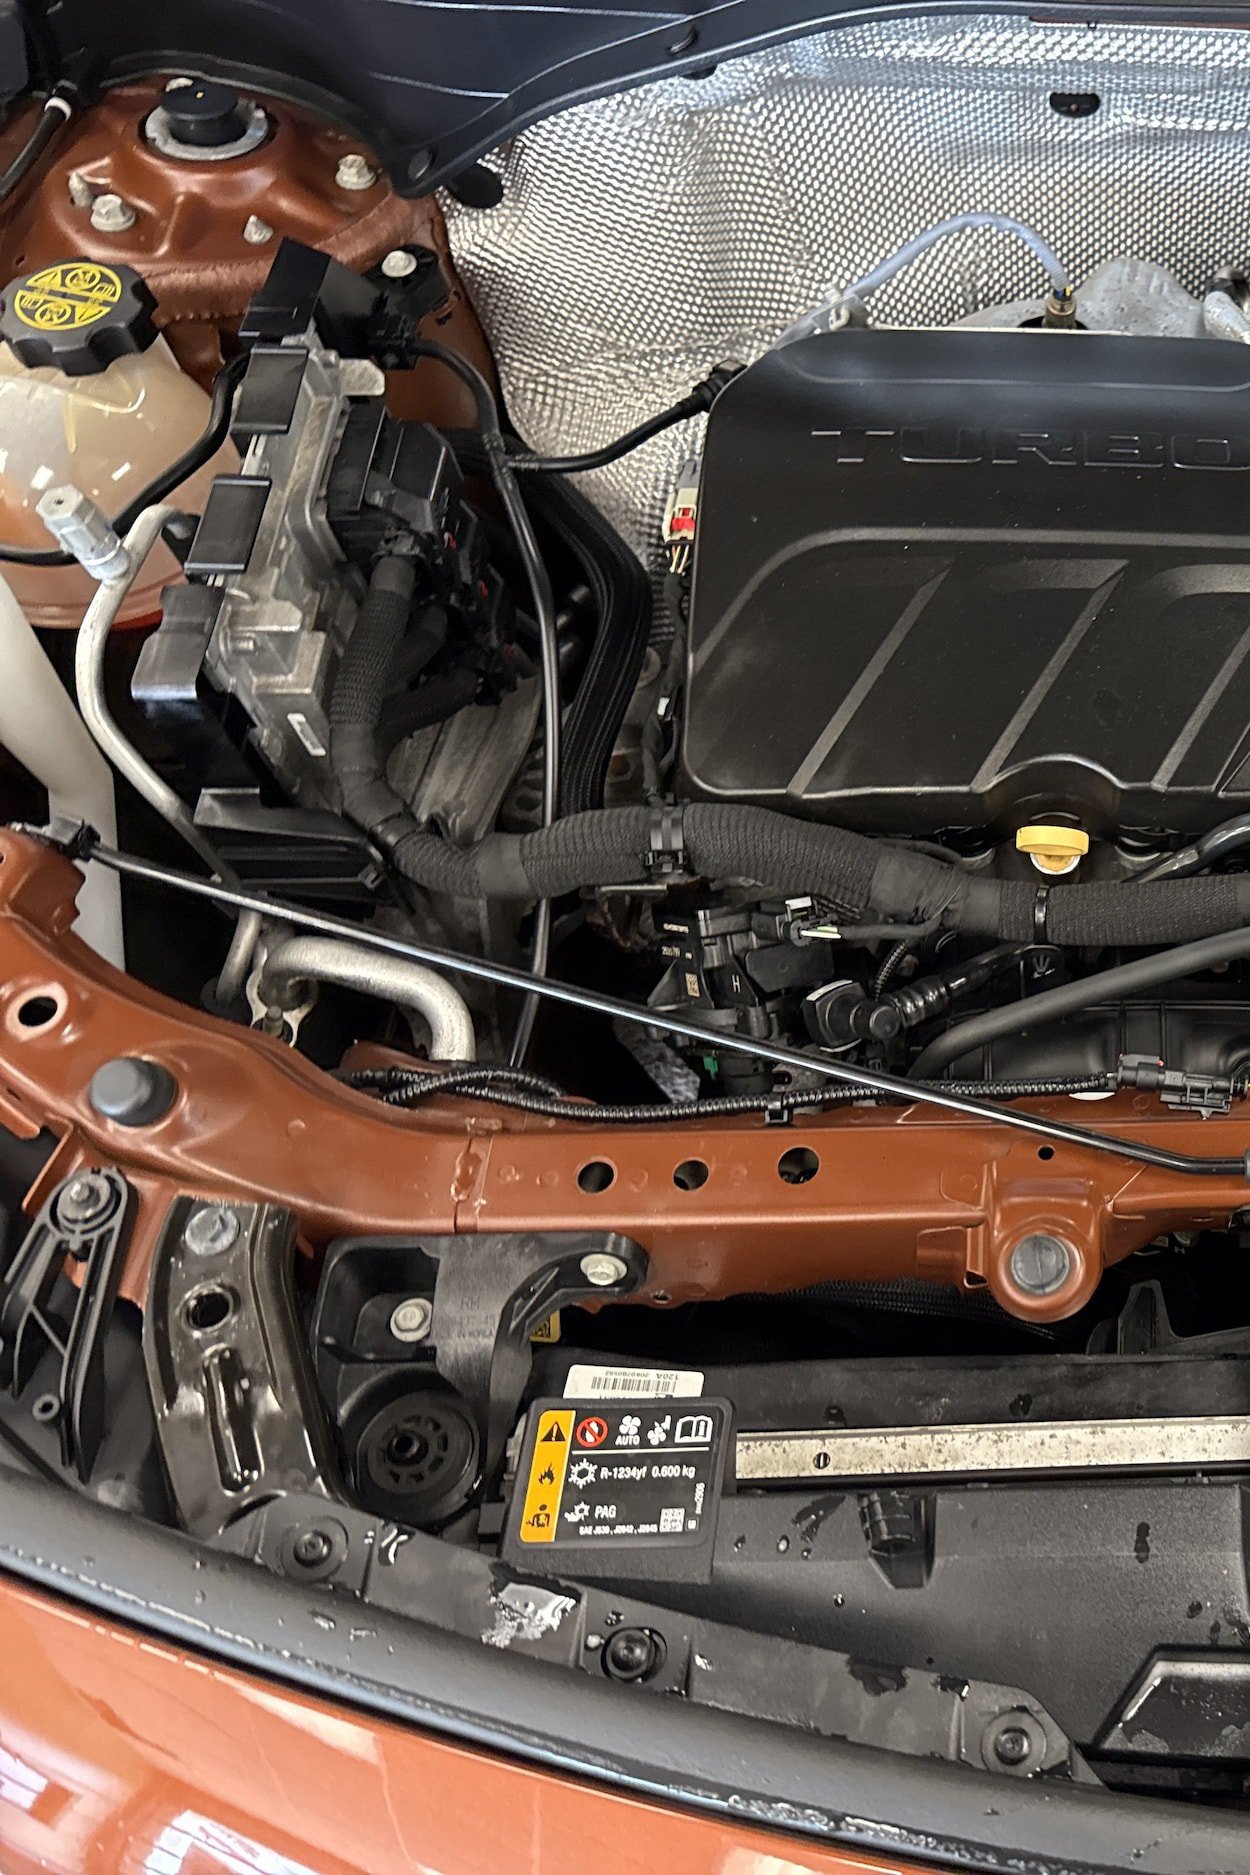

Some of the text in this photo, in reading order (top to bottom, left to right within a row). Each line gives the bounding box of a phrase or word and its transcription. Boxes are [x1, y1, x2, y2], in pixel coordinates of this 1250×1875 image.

[656, 1372, 680, 1381] 120A
[615, 1435, 641, 1446] AUTO
[600, 1464, 696, 1481] R-1234yf 0.600 kg
[594, 1505, 617, 1519] PAG
